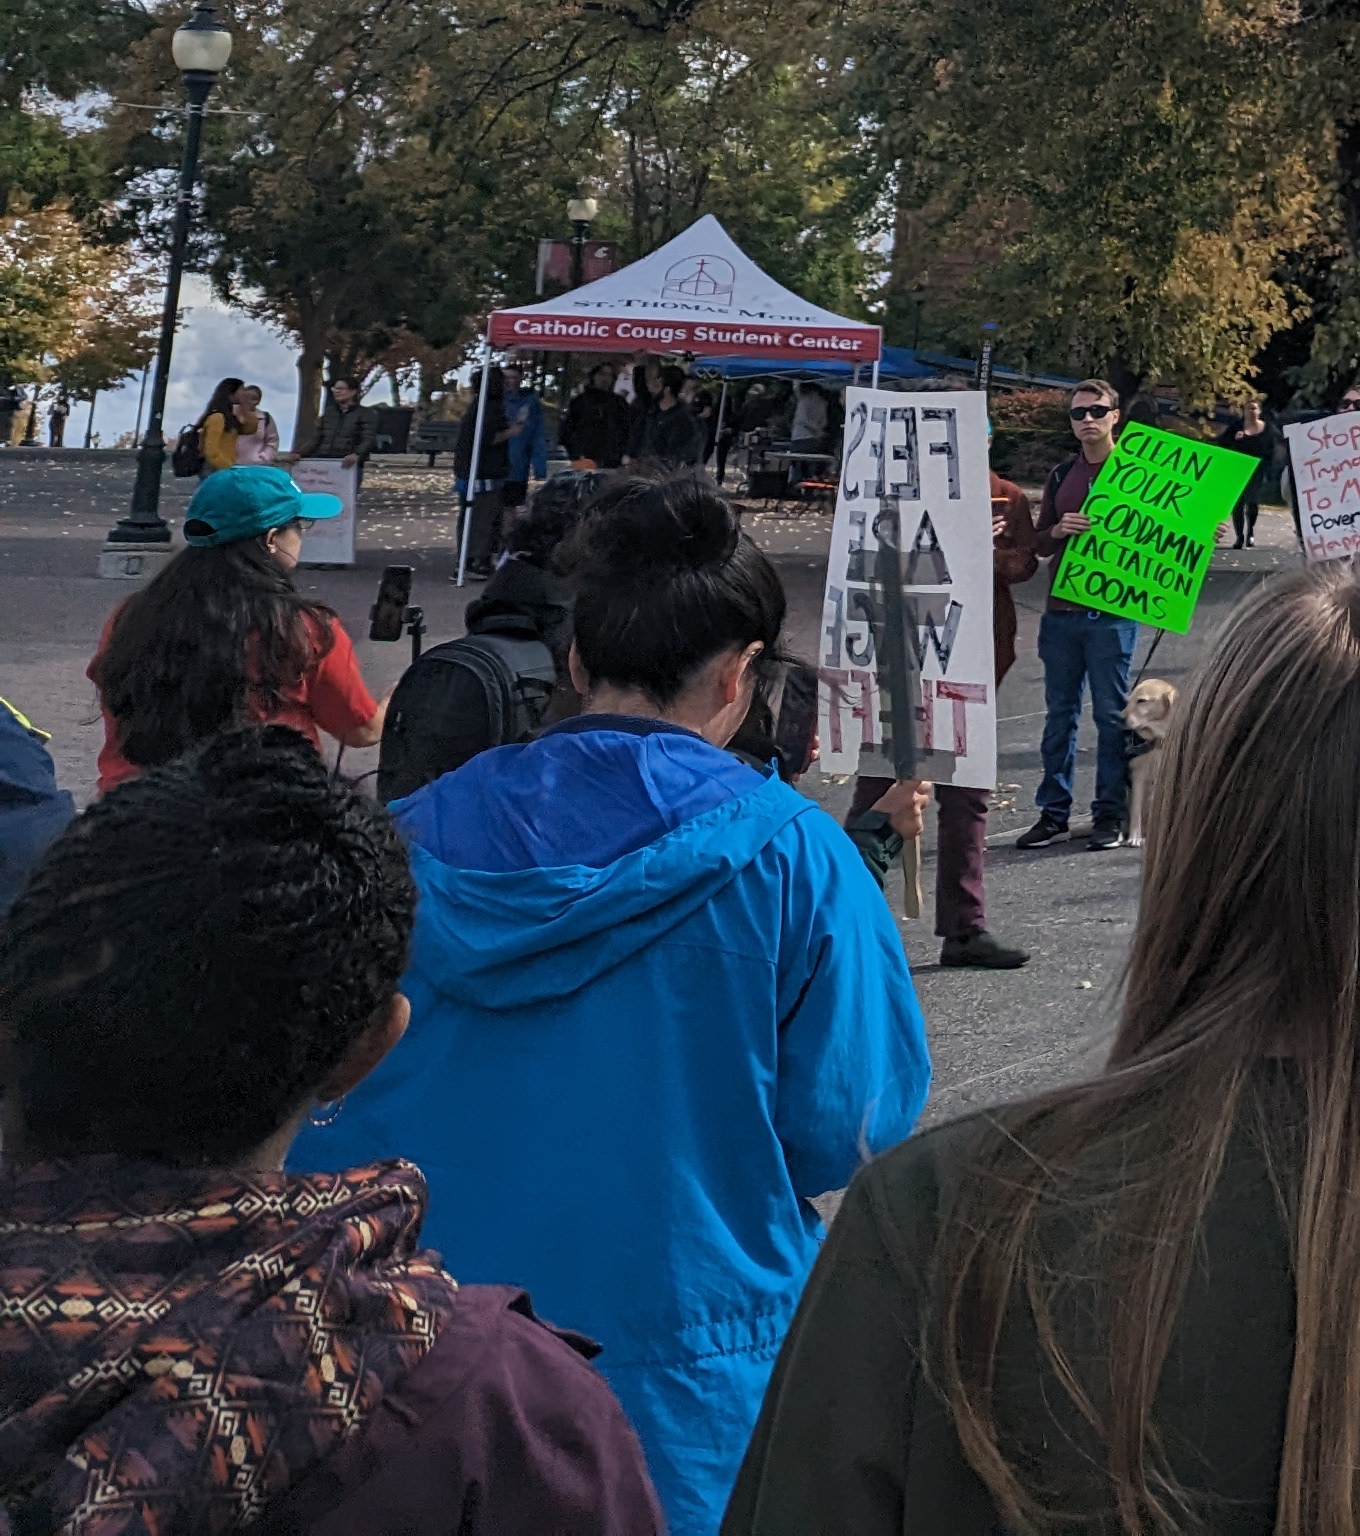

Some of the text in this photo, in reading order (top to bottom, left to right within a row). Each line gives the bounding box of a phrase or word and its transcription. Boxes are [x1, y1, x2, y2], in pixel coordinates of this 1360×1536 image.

[512, 318, 862, 352] Catholic Cougs Student Center
[1120, 431, 1213, 482] CLEAN
[1107, 455, 1193, 518] YOUR
[1302, 487, 1331, 511] To
[1084, 493, 1205, 574] GODDAMN
[1058, 561, 1168, 620] ROOMS
[1070, 534, 1194, 597] LACTATION
